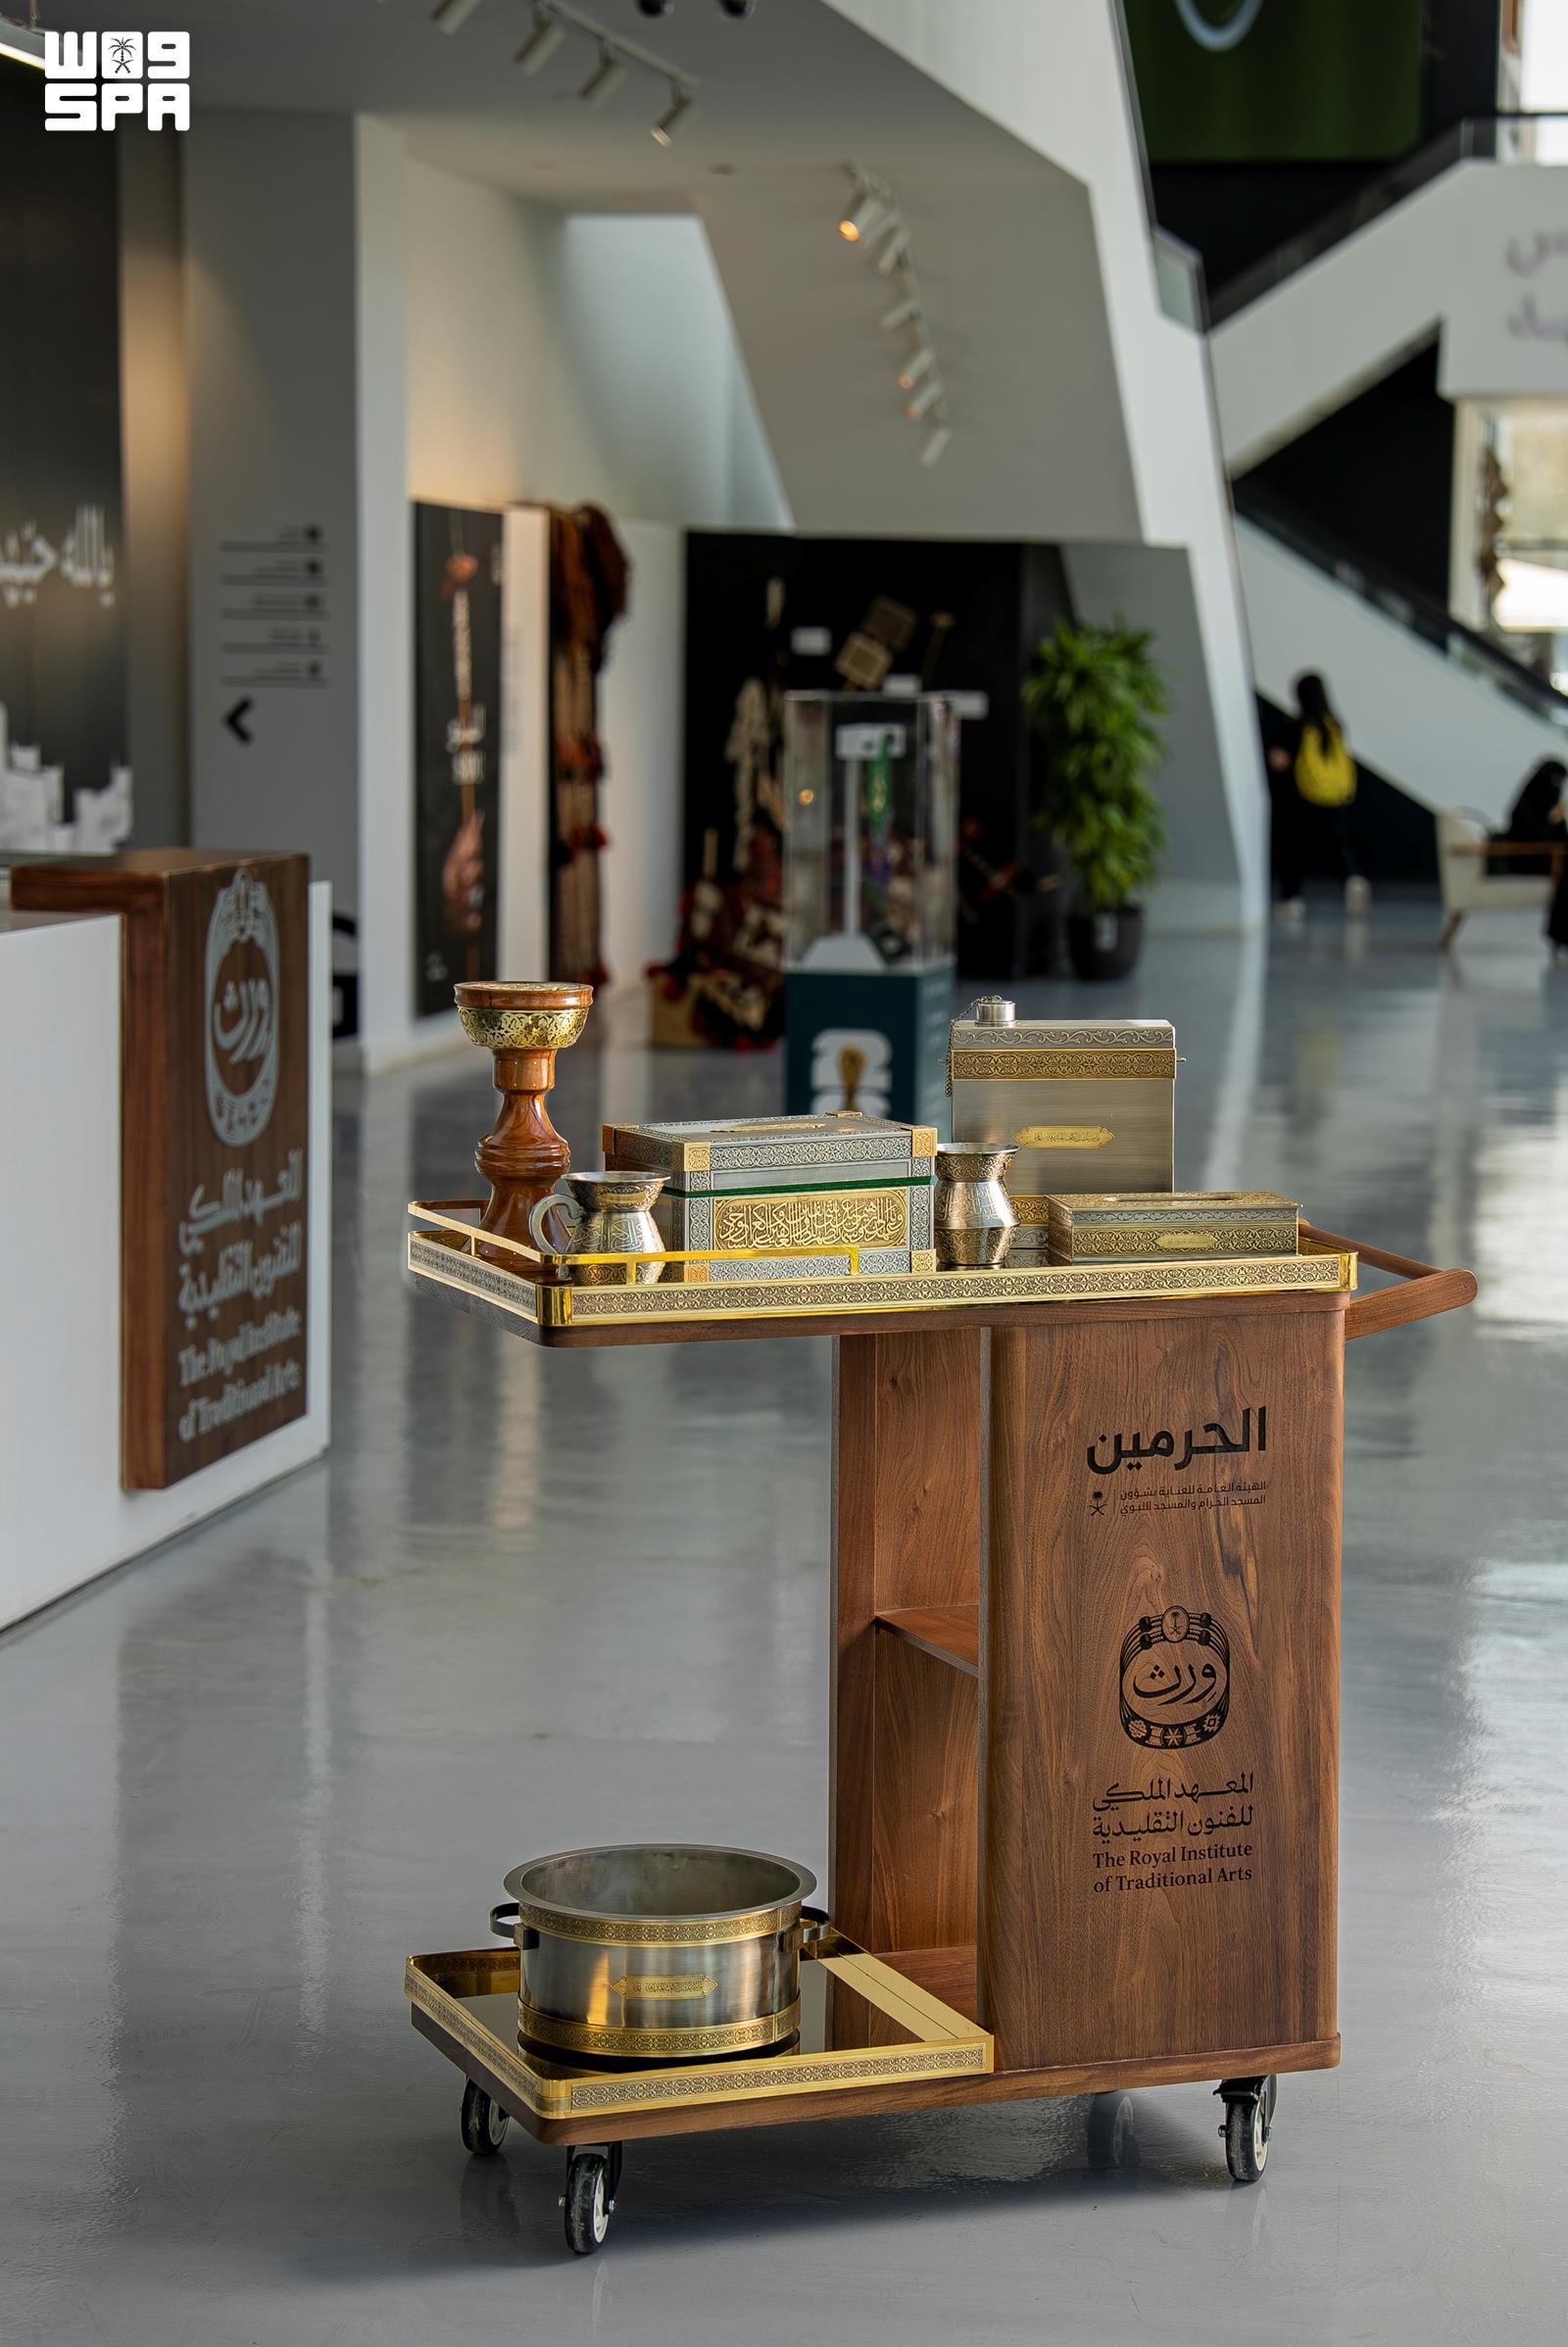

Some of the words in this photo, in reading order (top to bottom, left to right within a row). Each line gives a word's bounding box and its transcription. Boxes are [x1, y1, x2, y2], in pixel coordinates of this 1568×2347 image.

[1086, 1405, 1266, 1475] الحرمين
[1158, 1485, 1195, 1498] للعناية
[1197, 1482, 1234, 1494] العامة
[1236, 1481, 1266, 1492] الهيئة
[1120, 1501, 1152, 1516] النبوي
[1153, 1498, 1197, 1512] والمسجد
[1198, 1496, 1229, 1510] الحرام
[1231, 1495, 1266, 1508] المسجد
[1092, 1777, 1171, 1812] الملكي
[1174, 1771, 1254, 1803] المعهد
[1093, 1810, 1184, 1844] التقليدية
[1187, 1804, 1254, 1836] للفنون
[1093, 1852, 1125, 1869] The
[1129, 1846, 1176, 1868] Royal
[1181, 1843, 1253, 1862] Institute
[1093, 1876, 1114, 1893] of
[1115, 1868, 1213, 1891] Traditional
[1216, 1867, 1253, 1882] Arts
